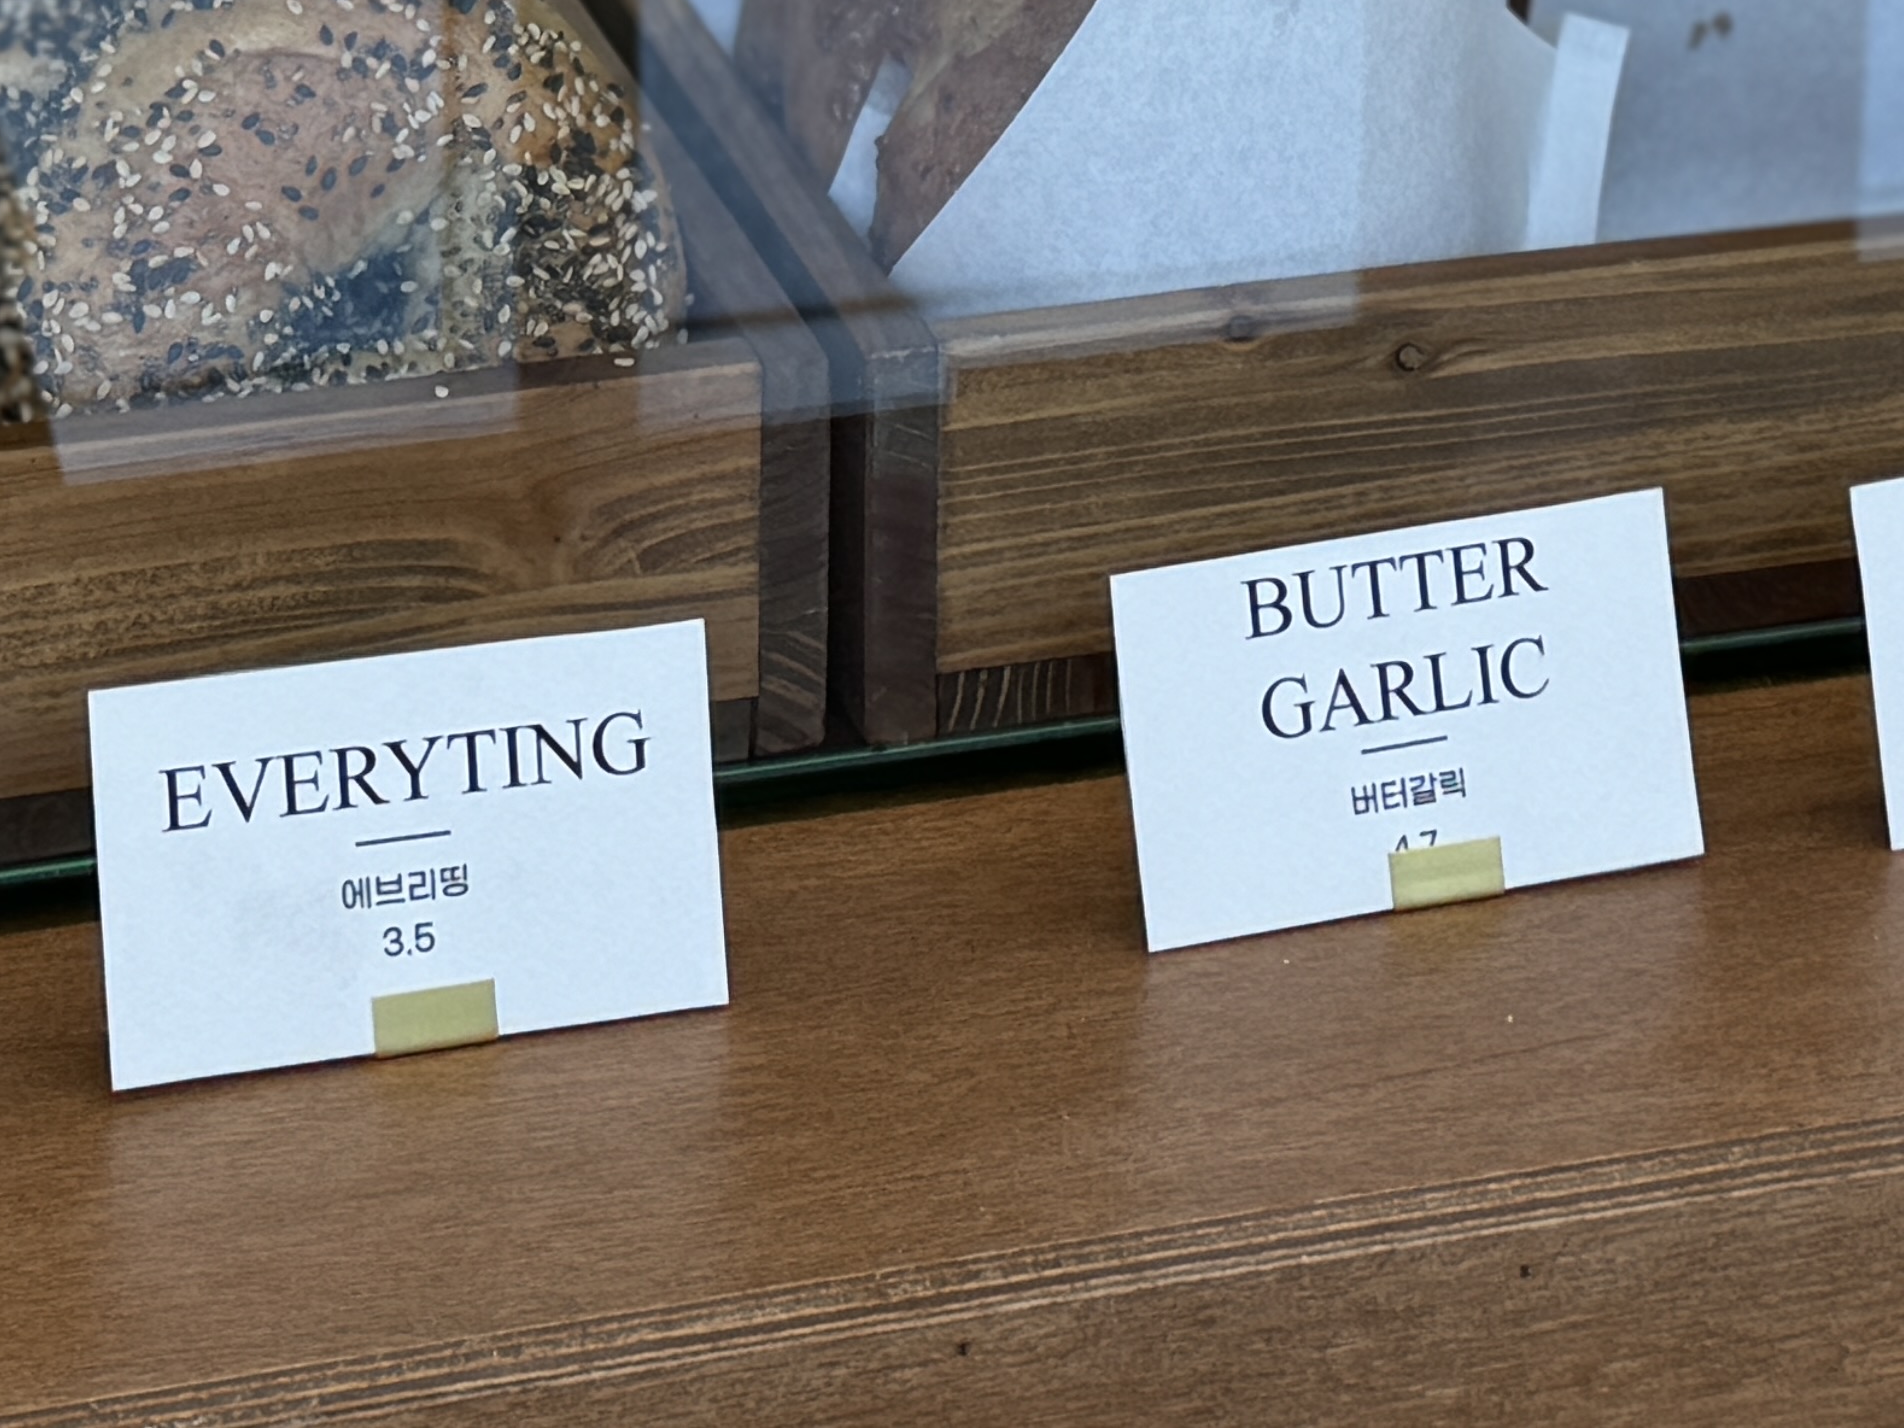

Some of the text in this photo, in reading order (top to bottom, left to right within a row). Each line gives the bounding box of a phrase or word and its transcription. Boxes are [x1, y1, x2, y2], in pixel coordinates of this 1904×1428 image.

[1241, 536, 1549, 640] BUTTER
[1261, 634, 1550, 739] GARLIC
[160, 709, 652, 832] EVERYTING
[1350, 767, 1467, 816] 버터갈릭
[1395, 829, 1438, 853] 47
[341, 863, 469, 910] 에브리띵
[382, 921, 436, 957] 3.5
